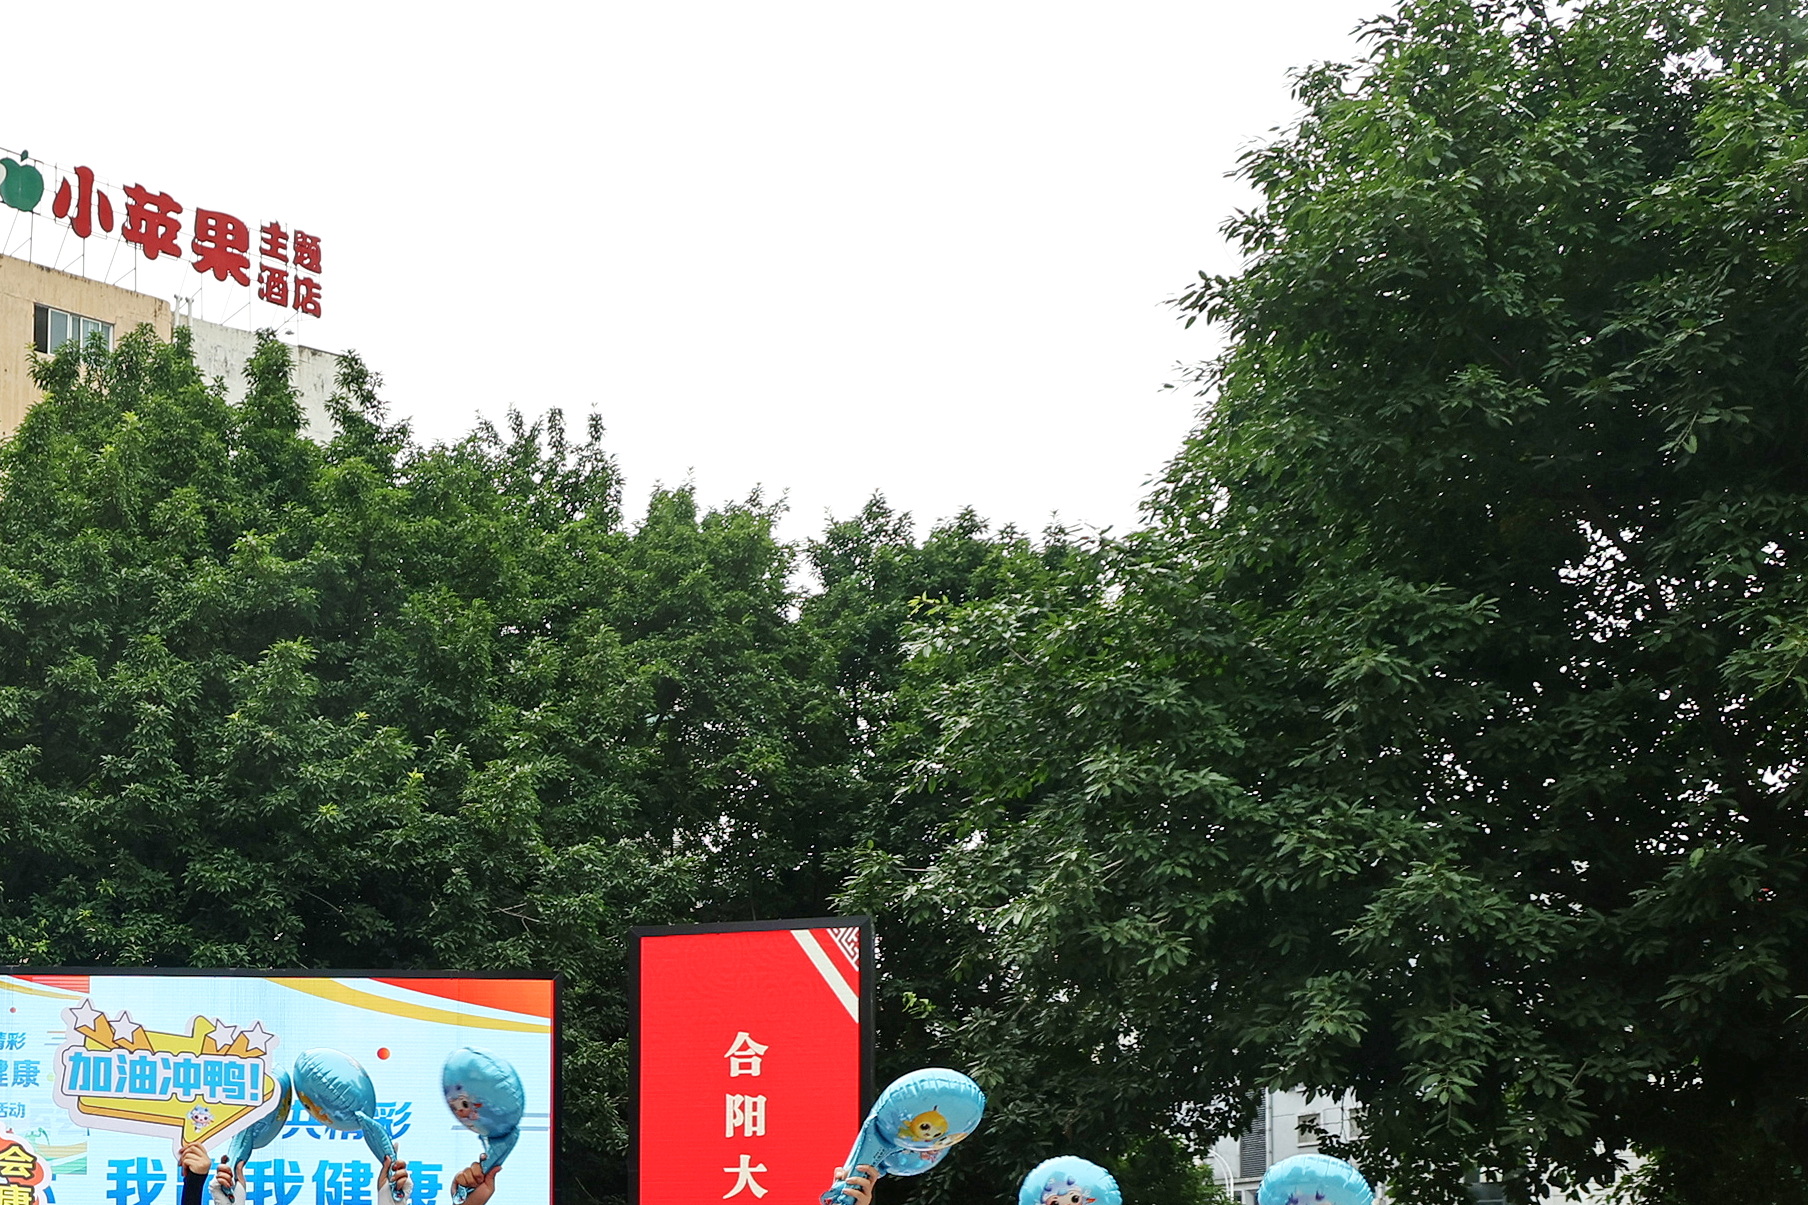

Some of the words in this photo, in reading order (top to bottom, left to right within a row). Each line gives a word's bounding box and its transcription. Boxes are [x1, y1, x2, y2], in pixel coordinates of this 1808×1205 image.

[52, 165, 250, 286] 小苹果
[259, 220, 322, 273] 主题
[258, 265, 322, 318] 酒店
[67, 1051, 261, 1103] 加油冲鸭!
